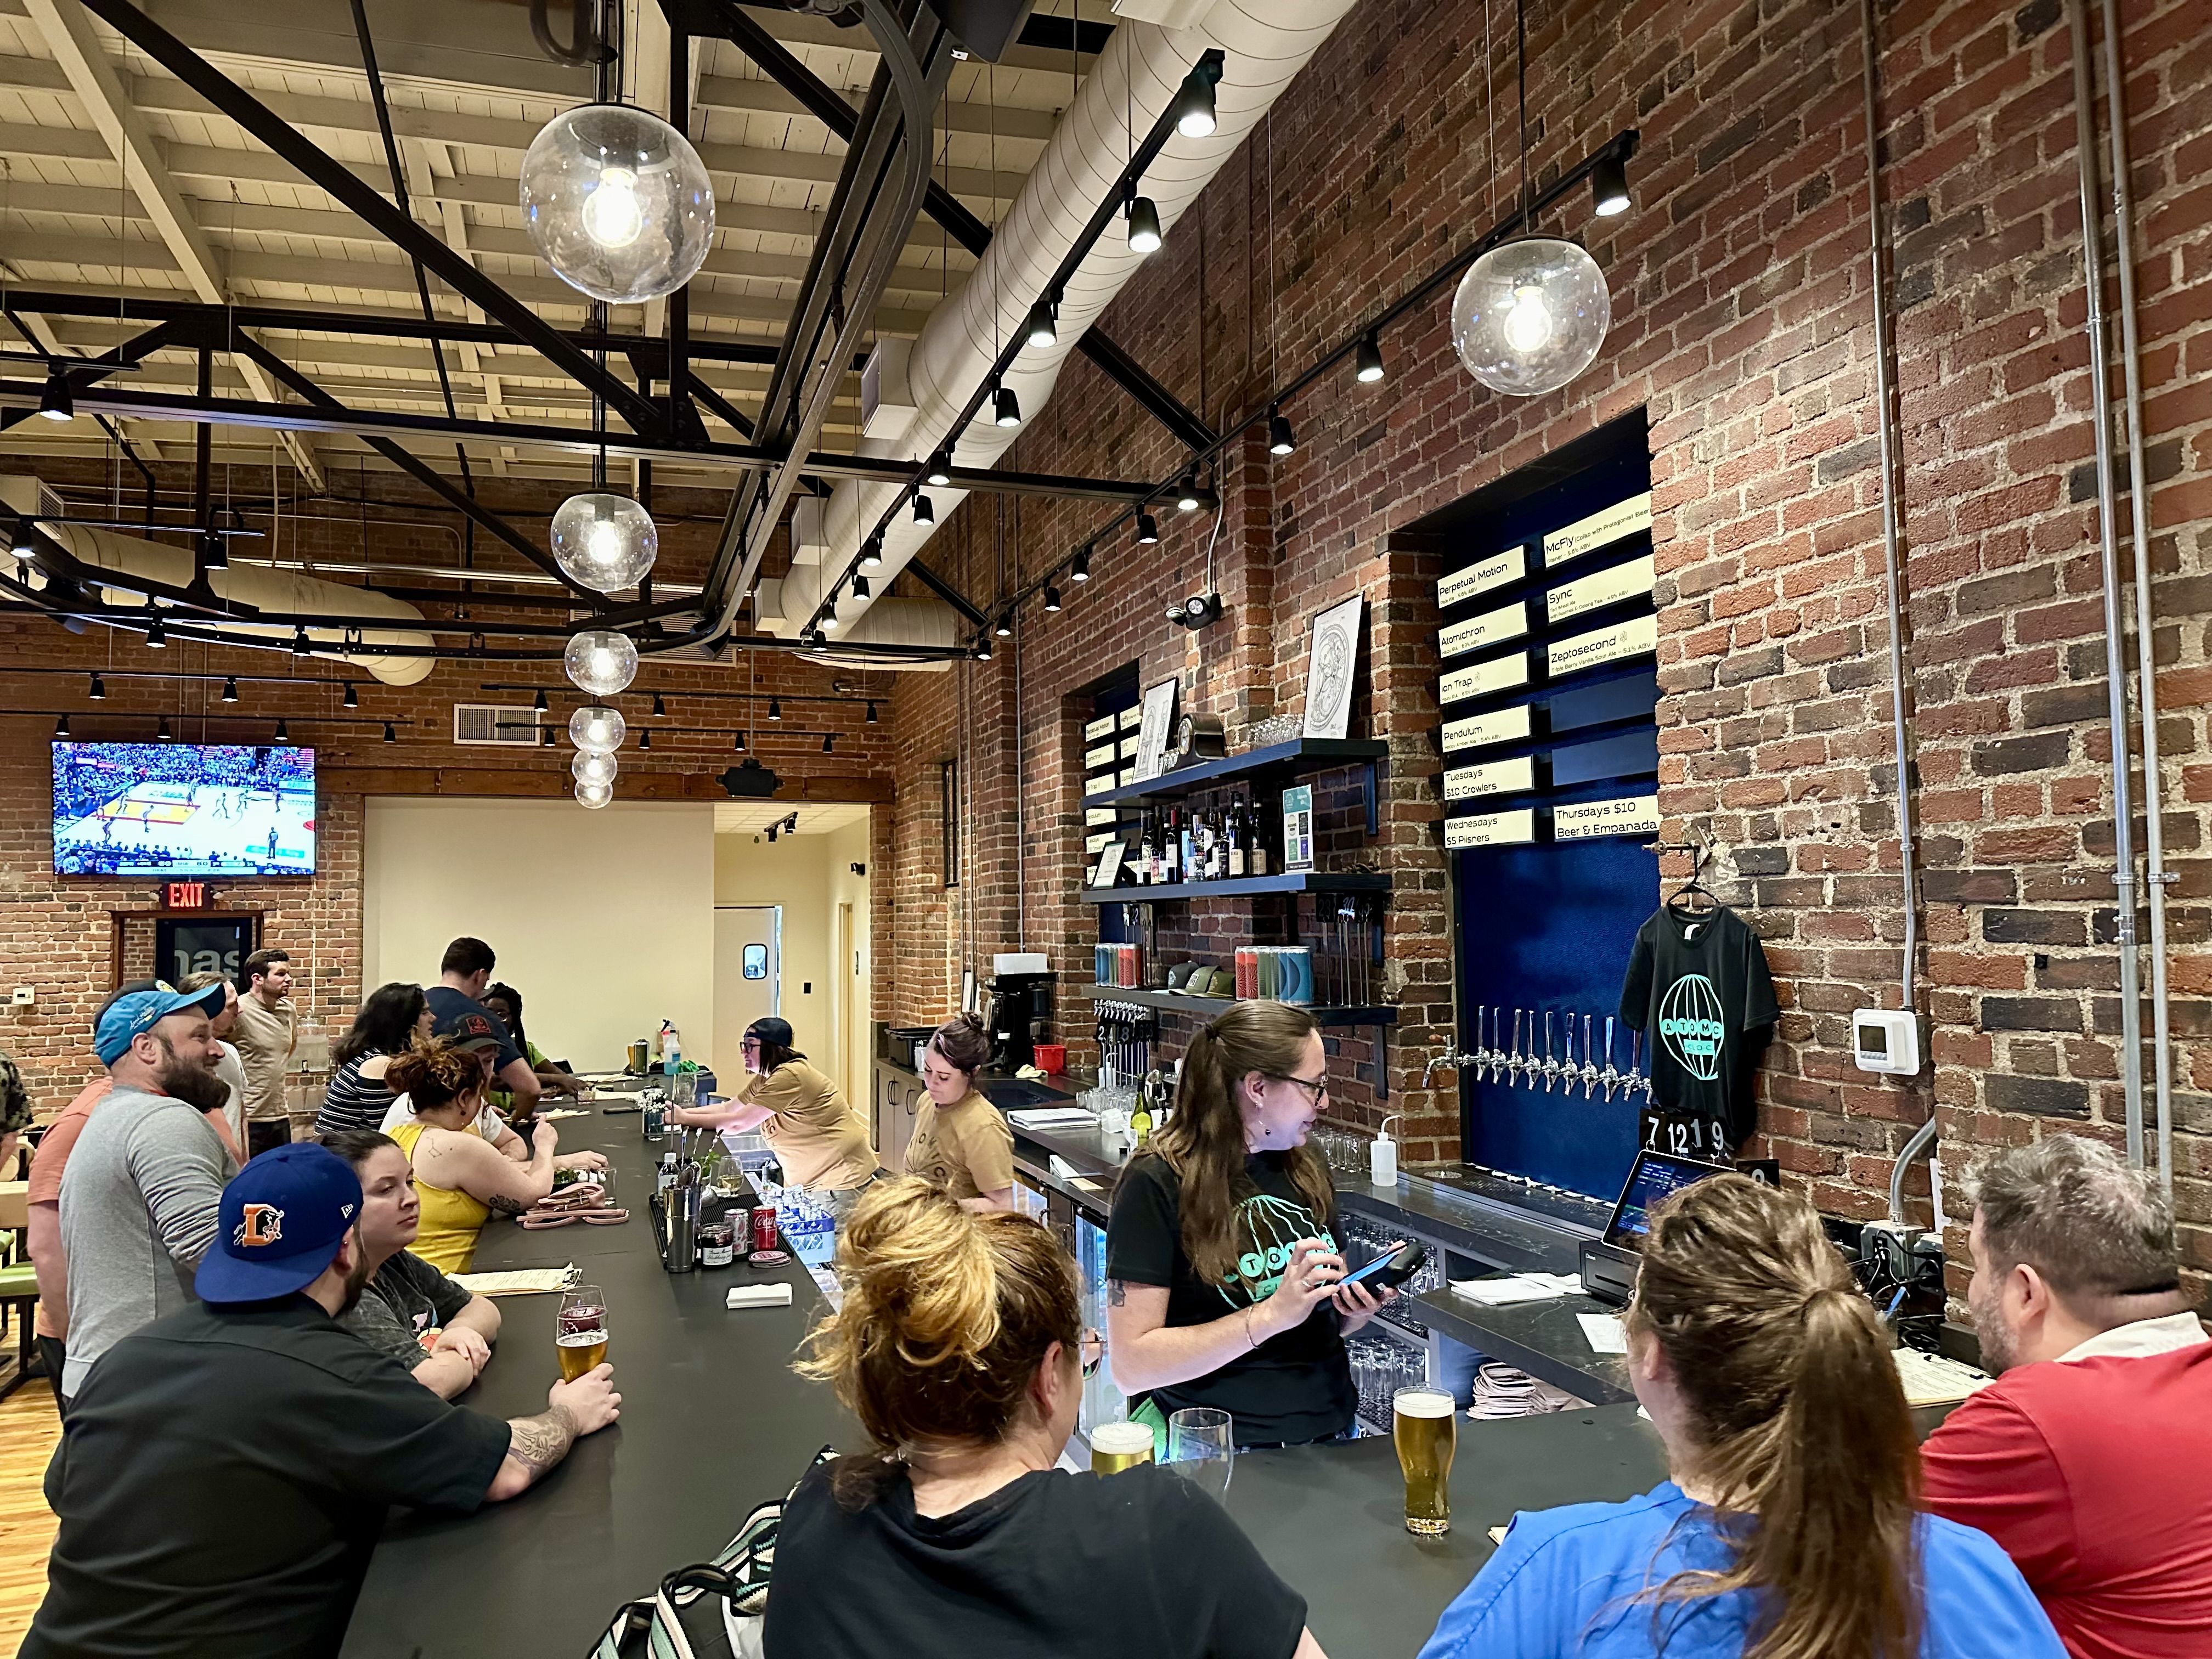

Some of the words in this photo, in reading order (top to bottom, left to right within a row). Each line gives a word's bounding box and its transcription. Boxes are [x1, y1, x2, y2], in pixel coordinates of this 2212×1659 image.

[1546, 536, 1575, 555] McFly
[1592, 527, 1602, 535] with
[1603, 514, 1634, 531] Protagonist
[1547, 555, 1562, 564] Pilsner
[1579, 542, 1591, 551] ABV
[1439, 574, 1476, 596] Perpetual
[1477, 563, 1508, 581] Motion
[1549, 589, 1572, 604] Sync
[1558, 608, 1574, 617] Peaches
[1442, 626, 1485, 646] Atomichron
[1551, 635, 1616, 663] Zeptosecond
[1578, 657, 1594, 665] Vanilla
[1638, 641, 1651, 650] ABV
[1441, 684, 1452, 693] Ion
[1454, 678, 1472, 687] Trap
[1444, 726, 1482, 741] Pendulum
[1446, 769, 1483, 782] Tuesdays
[1446, 787, 1460, 797] $10
[1462, 783, 1497, 794] Crowlers
[1556, 806, 1610, 820] Thursdays
[1614, 802, 1636, 815] $10
[1447, 817, 1498, 830] Wednesdays
[1558, 827, 1579, 837] Beer
[1583, 825, 1590, 835] &
[1594, 820, 1657, 834] Empanada
[1447, 836, 1457, 845] $5
[1458, 834, 1489, 843] Pilsners
[169, 883, 205, 907] EXIT
[1648, 1116, 1659, 1144] 7
[1668, 1123, 1689, 1154] 12
